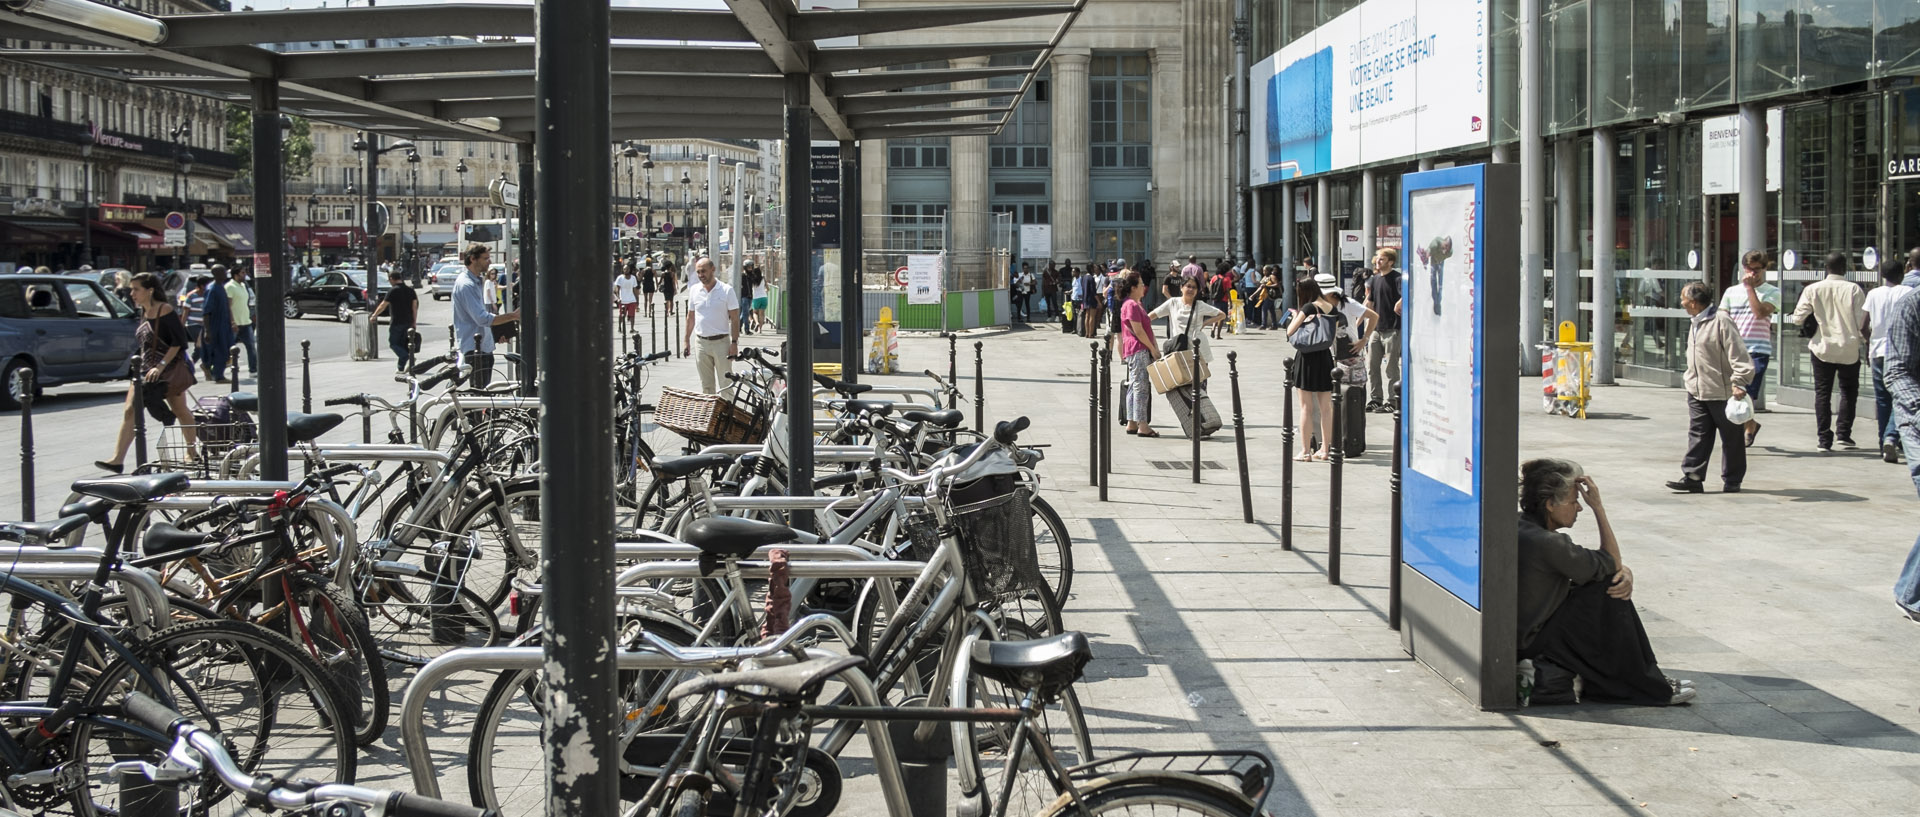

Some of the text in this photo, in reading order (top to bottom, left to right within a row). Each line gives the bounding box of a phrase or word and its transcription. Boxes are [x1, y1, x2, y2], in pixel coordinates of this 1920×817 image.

[1476, 10, 1483, 37] DU
[1349, 34, 1437, 87] VOTRE GARE SE REFAIT
[1350, 37, 1371, 64] ENTRE
[1372, 28, 1387, 55] 2014
[1389, 23, 1398, 47] ET
[1349, 75, 1393, 114] UNE BEAUTÉ
[92, 123, 124, 149] Mercure
